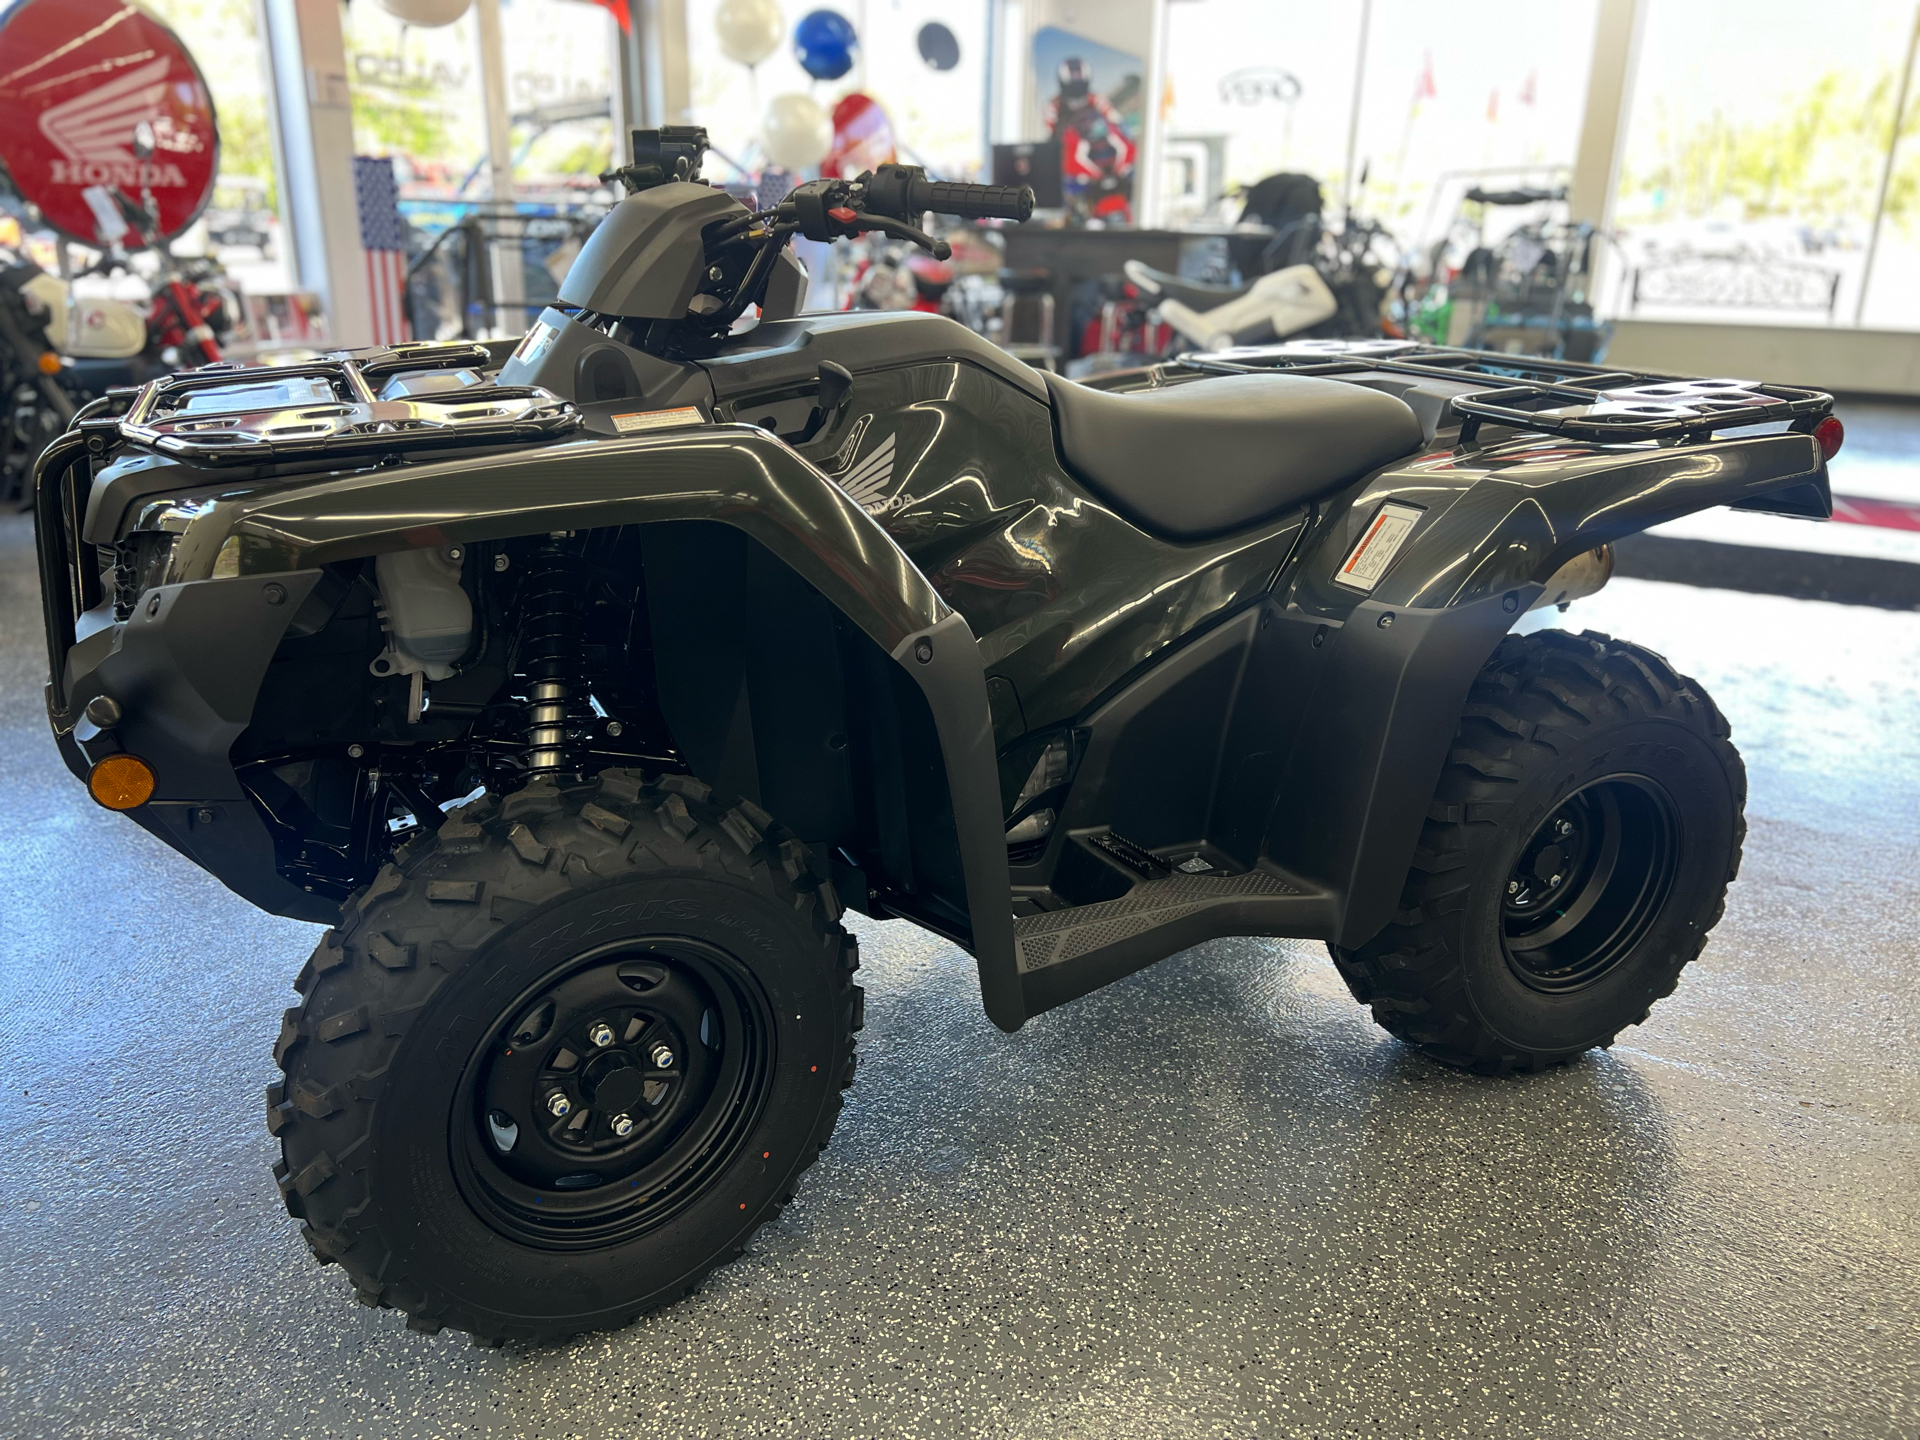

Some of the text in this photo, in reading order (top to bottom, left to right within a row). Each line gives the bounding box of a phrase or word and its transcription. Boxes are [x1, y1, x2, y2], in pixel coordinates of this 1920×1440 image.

[48, 159, 188, 187] HONDA
[862, 493, 918, 516] ONDA
[1357, 526, 1378, 554] WARNING
